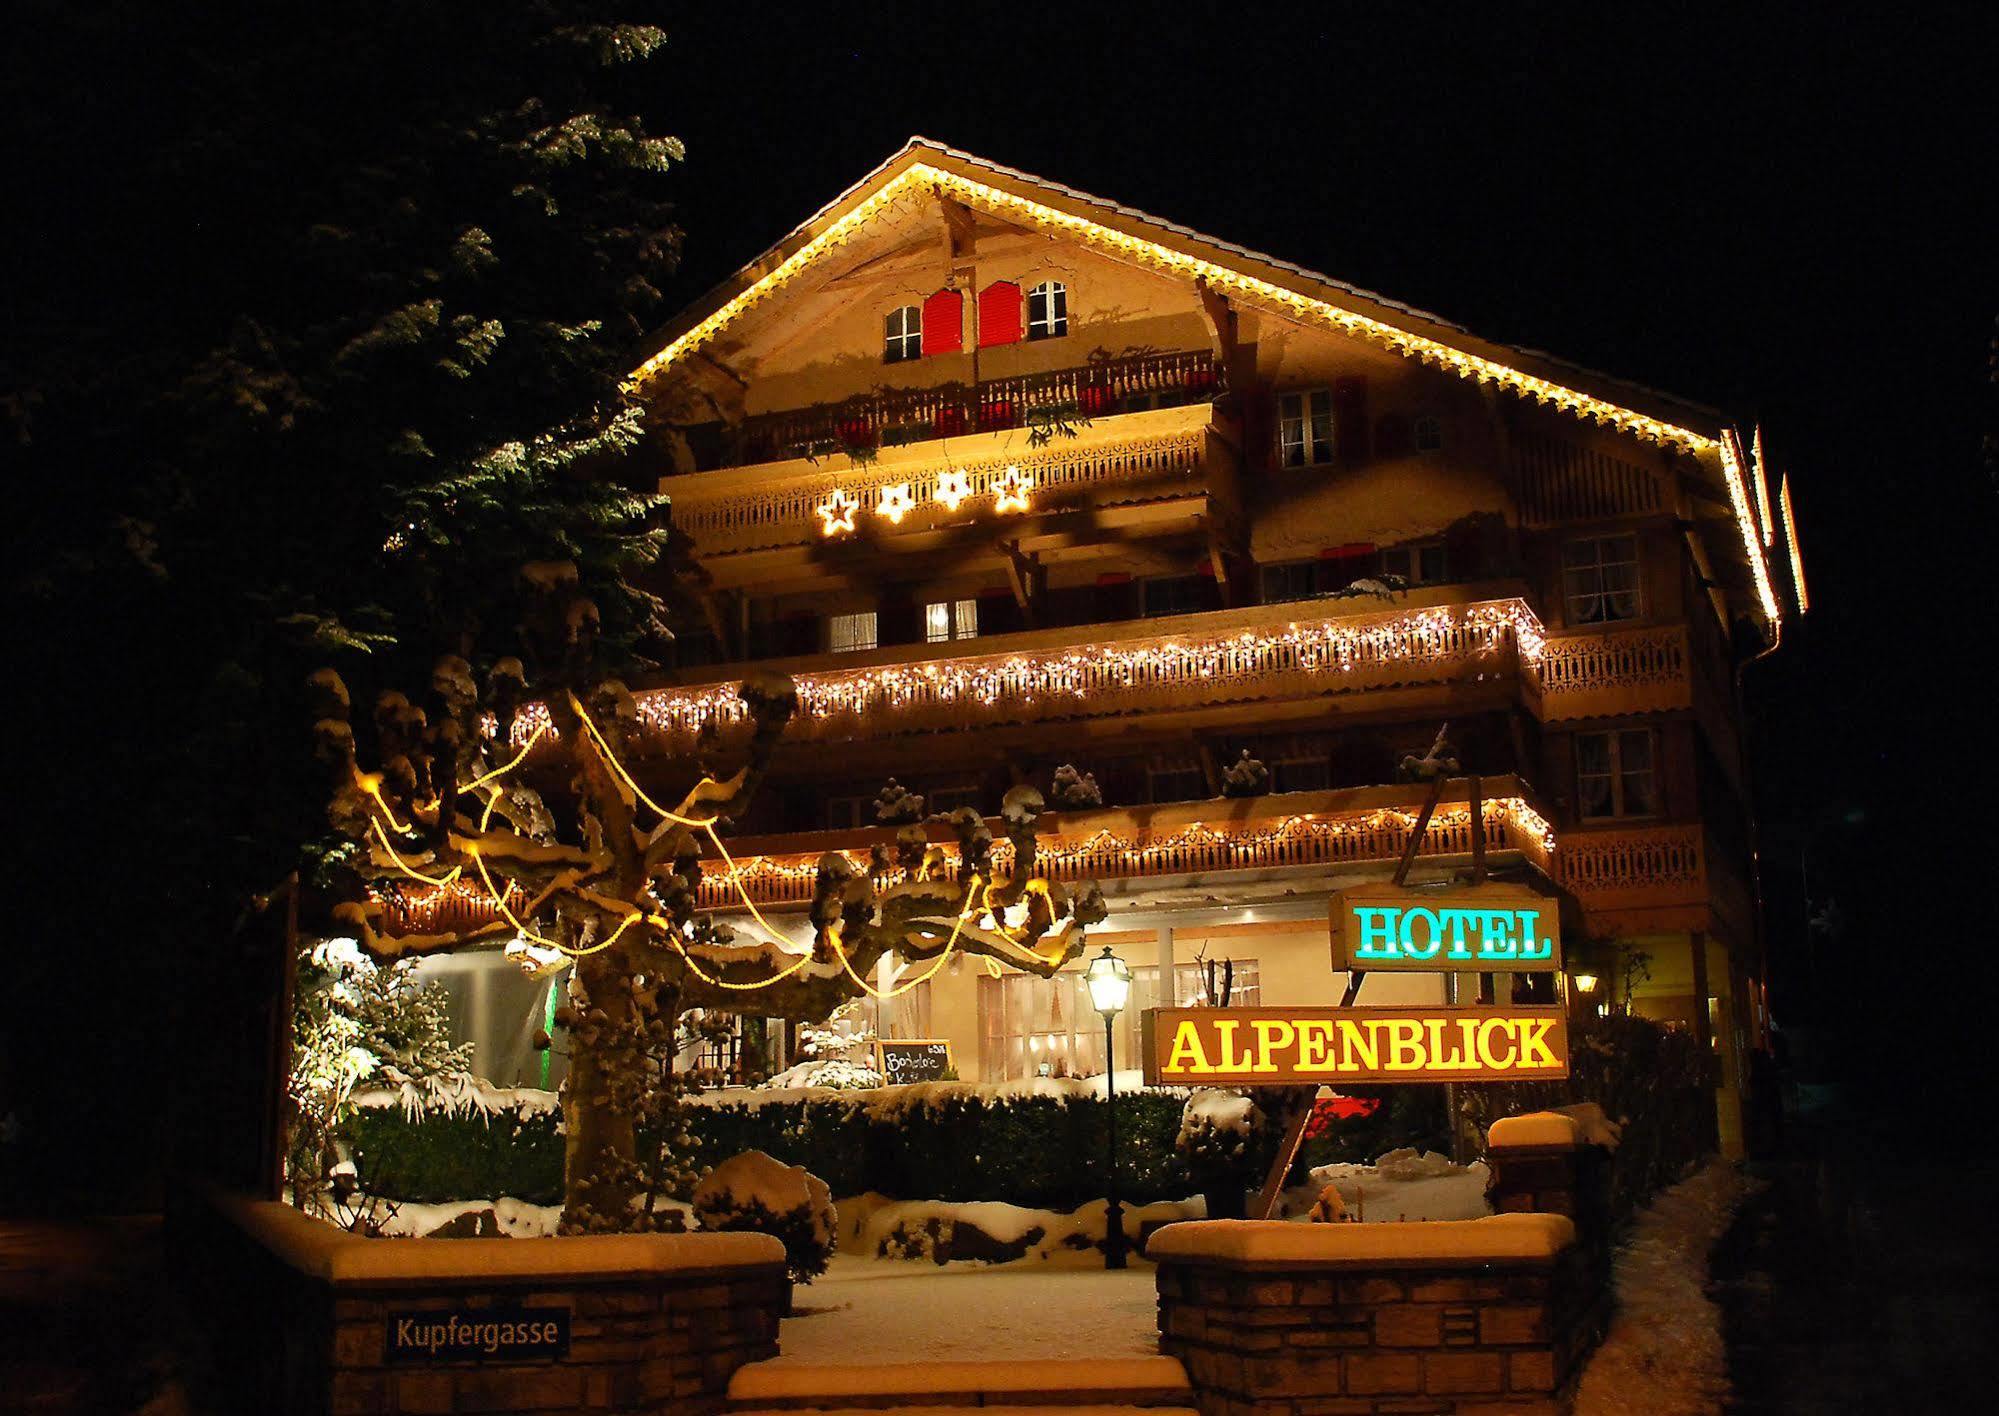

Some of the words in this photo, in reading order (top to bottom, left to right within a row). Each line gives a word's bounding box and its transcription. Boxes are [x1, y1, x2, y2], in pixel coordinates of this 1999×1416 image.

[1353, 907, 1552, 960] HOTEL
[1160, 1018, 1563, 1074] ALPENBLICK
[397, 1315, 559, 1354] Kupfergasse
